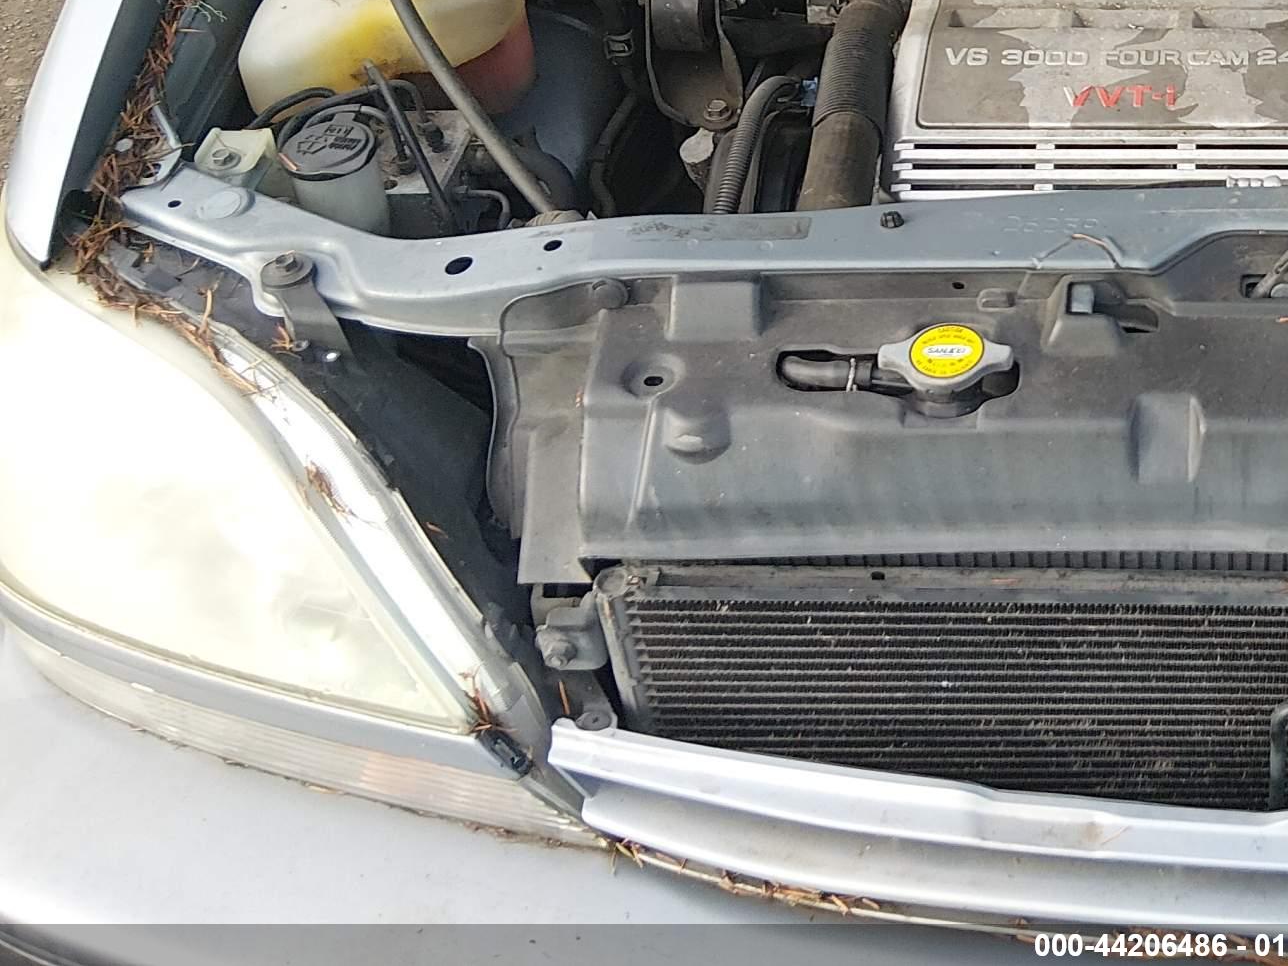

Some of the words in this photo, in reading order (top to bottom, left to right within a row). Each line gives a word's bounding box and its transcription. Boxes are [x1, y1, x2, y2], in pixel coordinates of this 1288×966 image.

[945, 47, 988, 66] V6
[1001, 49, 1088, 66] 3000
[1101, 48, 1182, 66] FOUR
[1187, 48, 1250, 67] CAM
[1063, 85, 1178, 107] VVT-i
